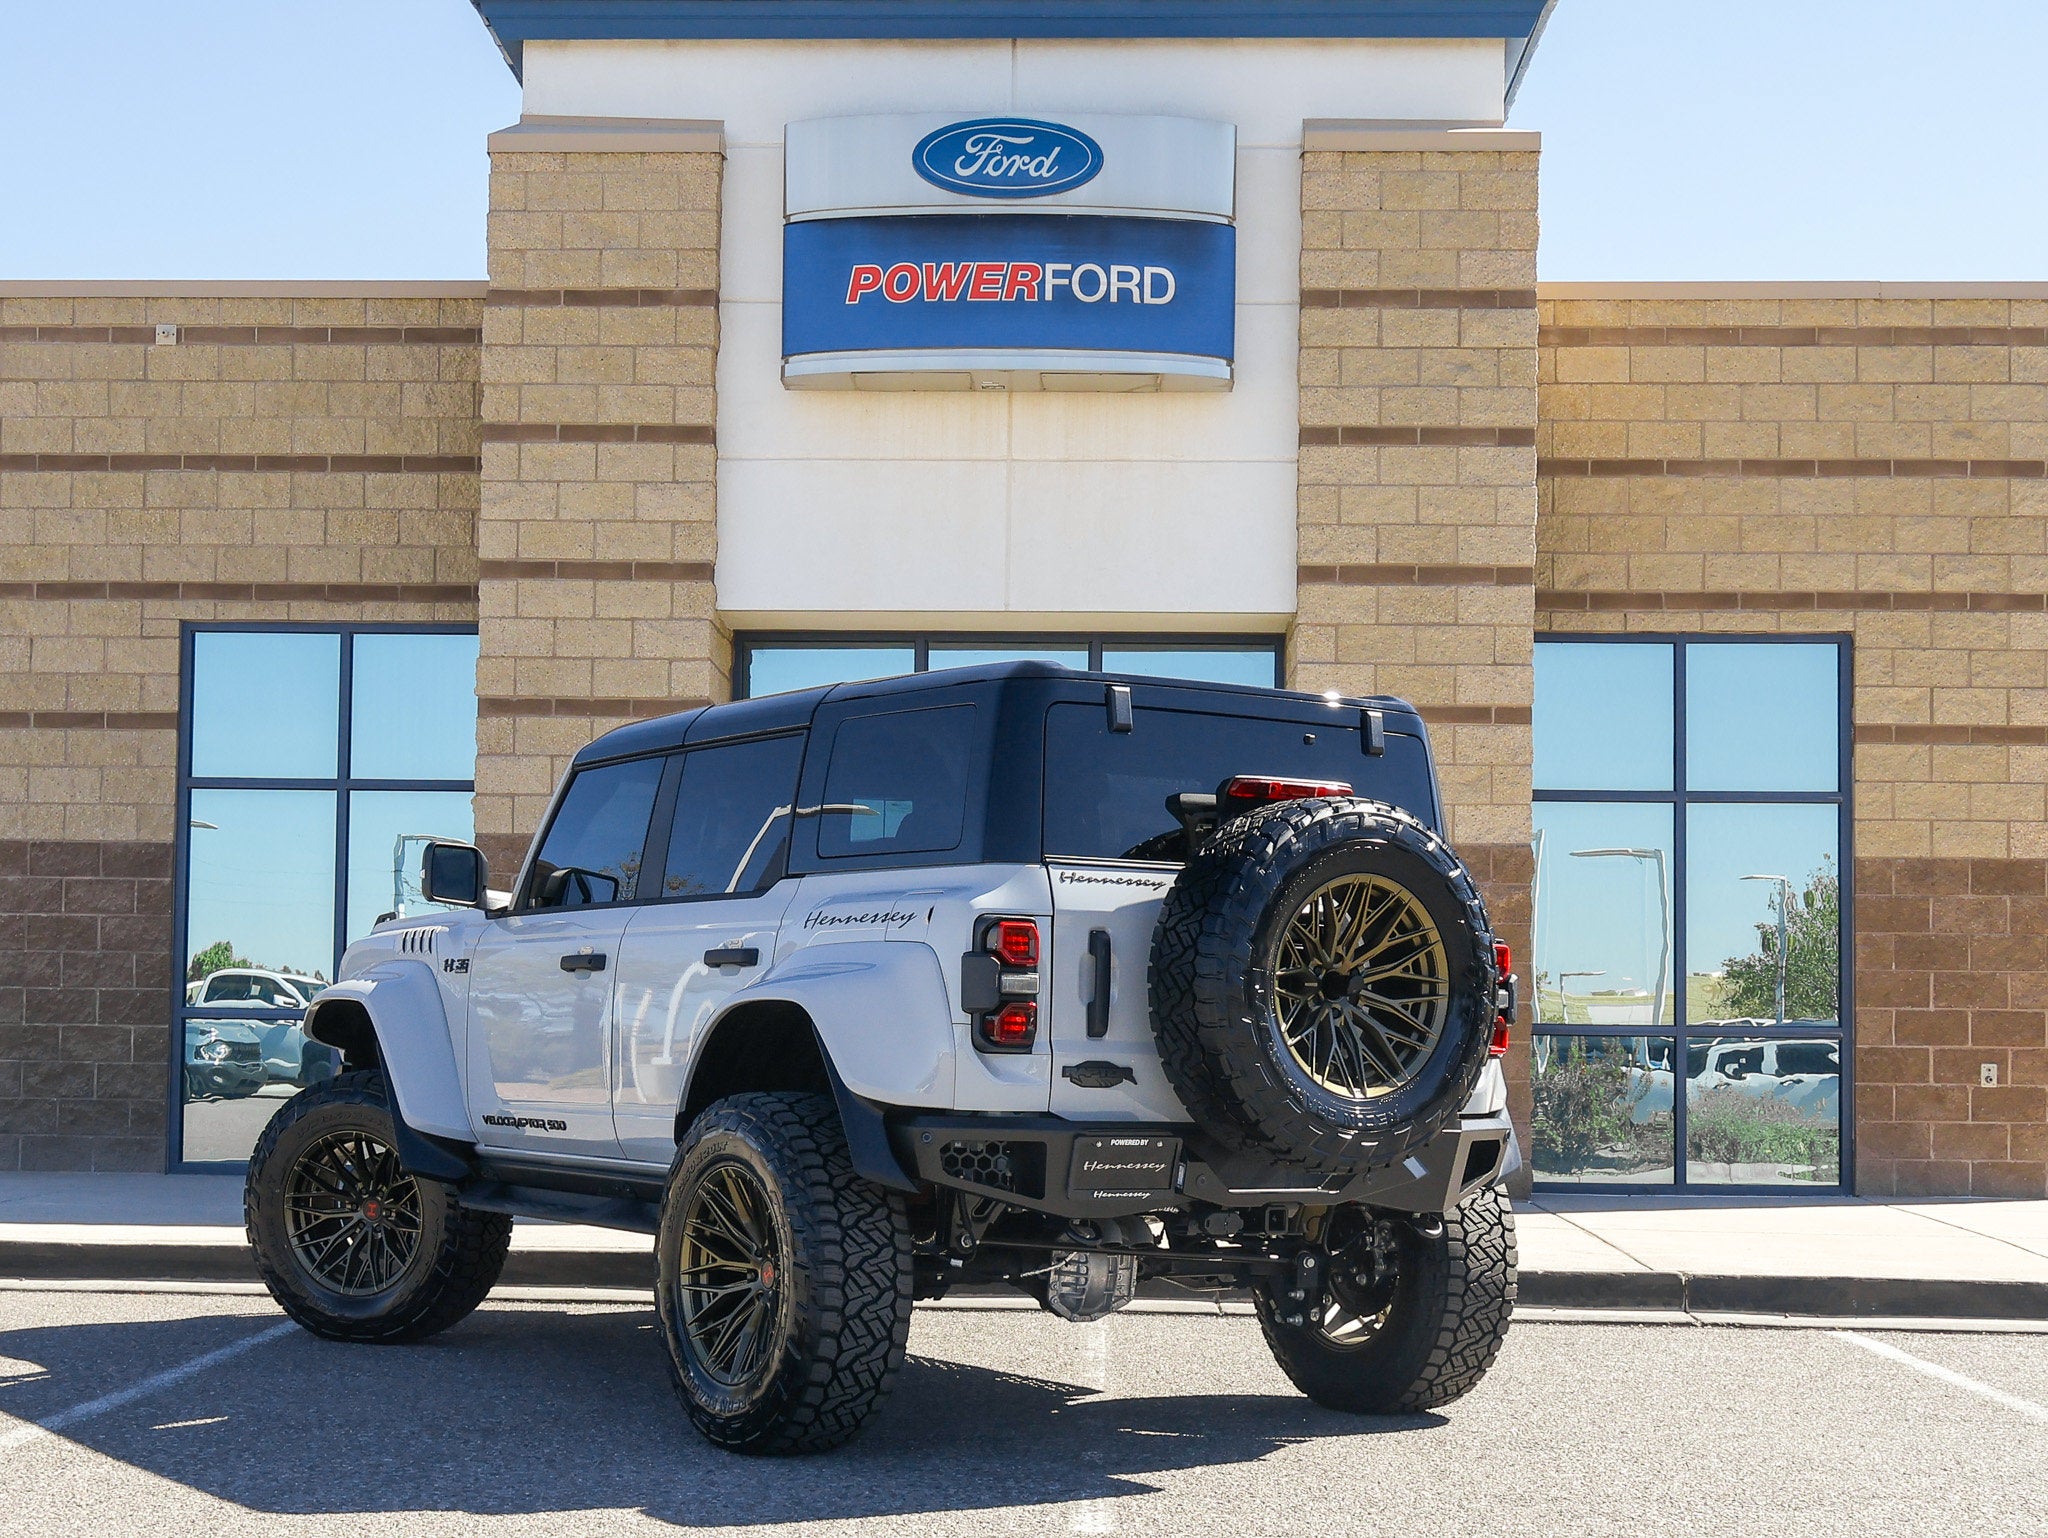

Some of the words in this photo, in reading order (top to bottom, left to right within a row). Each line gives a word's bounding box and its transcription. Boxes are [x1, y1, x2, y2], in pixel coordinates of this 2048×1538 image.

[954, 133, 1060, 178] Ford
[1059, 871, 1166, 891] Hennessey
[803, 910, 917, 929] Hennessey
[547, 1120, 567, 1131] 500
[1083, 1160, 1167, 1172] Hennessey
[1093, 1190, 1151, 1199] Hennessey
